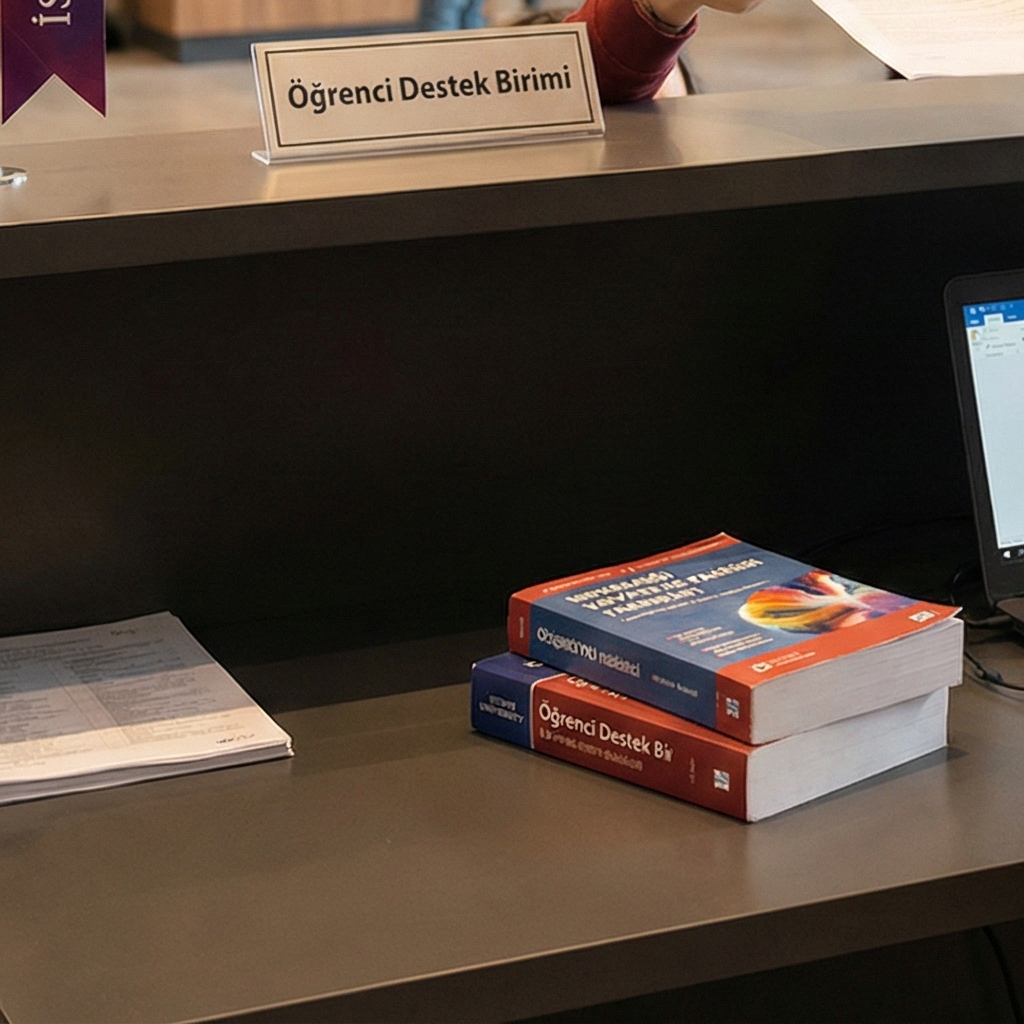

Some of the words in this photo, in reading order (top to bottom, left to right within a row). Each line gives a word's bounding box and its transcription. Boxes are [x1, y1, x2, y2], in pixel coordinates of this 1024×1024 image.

[287, 77, 394, 115] Öğrenci
[399, 71, 491, 102] Destek
[495, 65, 572, 95] Birimi
[599, 721, 651, 757] Destek
